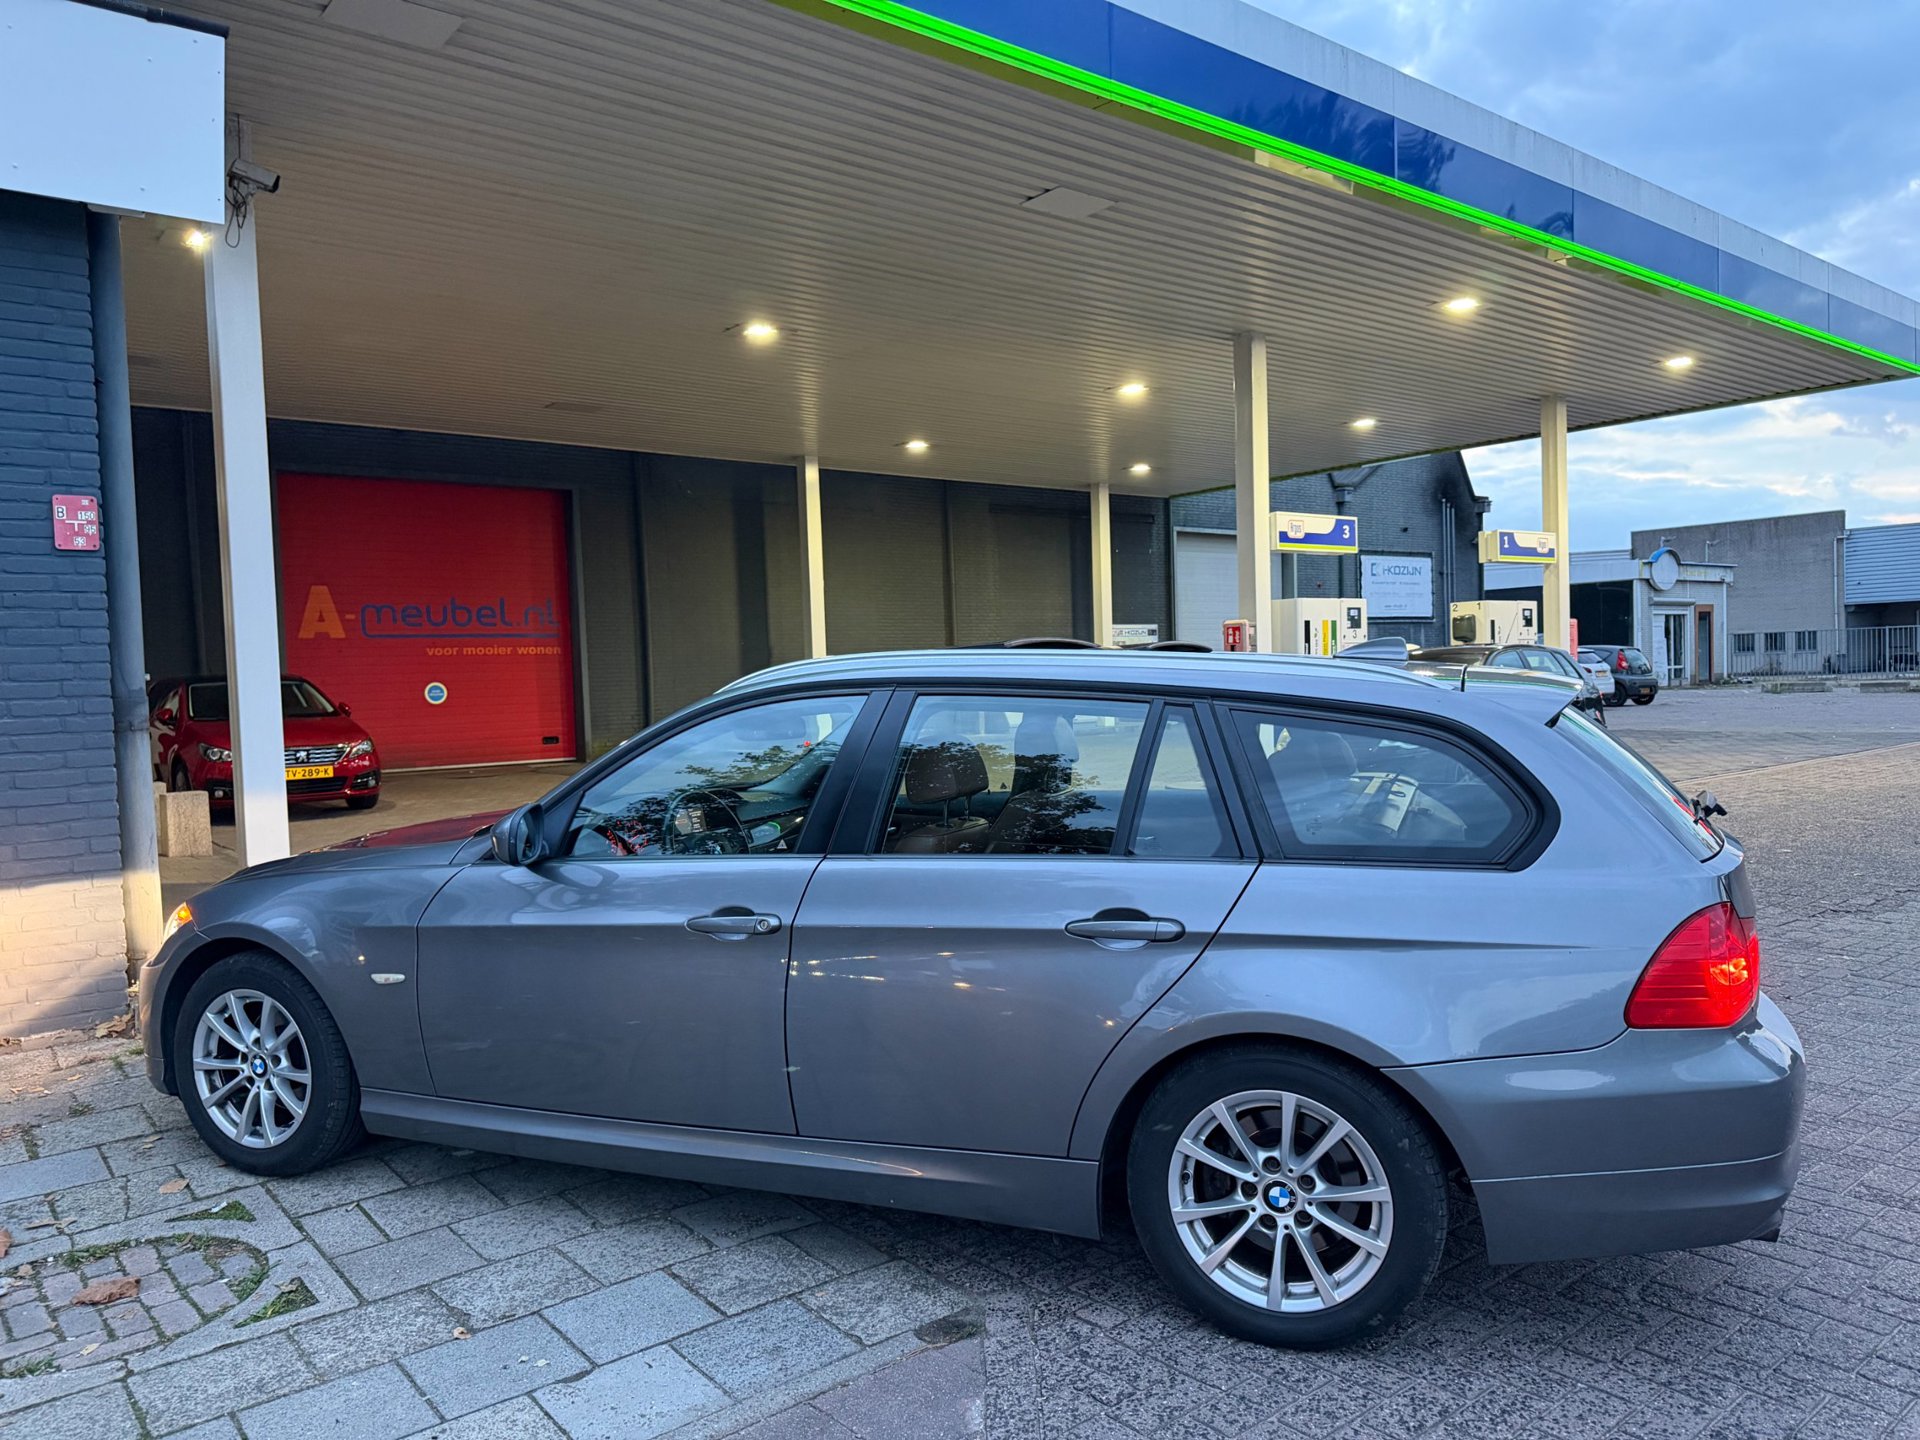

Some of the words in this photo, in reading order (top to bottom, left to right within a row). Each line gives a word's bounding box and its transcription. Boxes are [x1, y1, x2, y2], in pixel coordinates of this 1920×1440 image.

[56, 506, 65, 518] B
[1342, 525, 1350, 539] 3
[1503, 535, 1510, 548] 1
[1452, 604, 1458, 612] 2
[1352, 630, 1357, 639] 3
[426, 646, 459, 656] voor
[462, 644, 514, 656] mooier
[516, 645, 561, 656] wonen
[286, 767, 330, 778] TV-289-K
